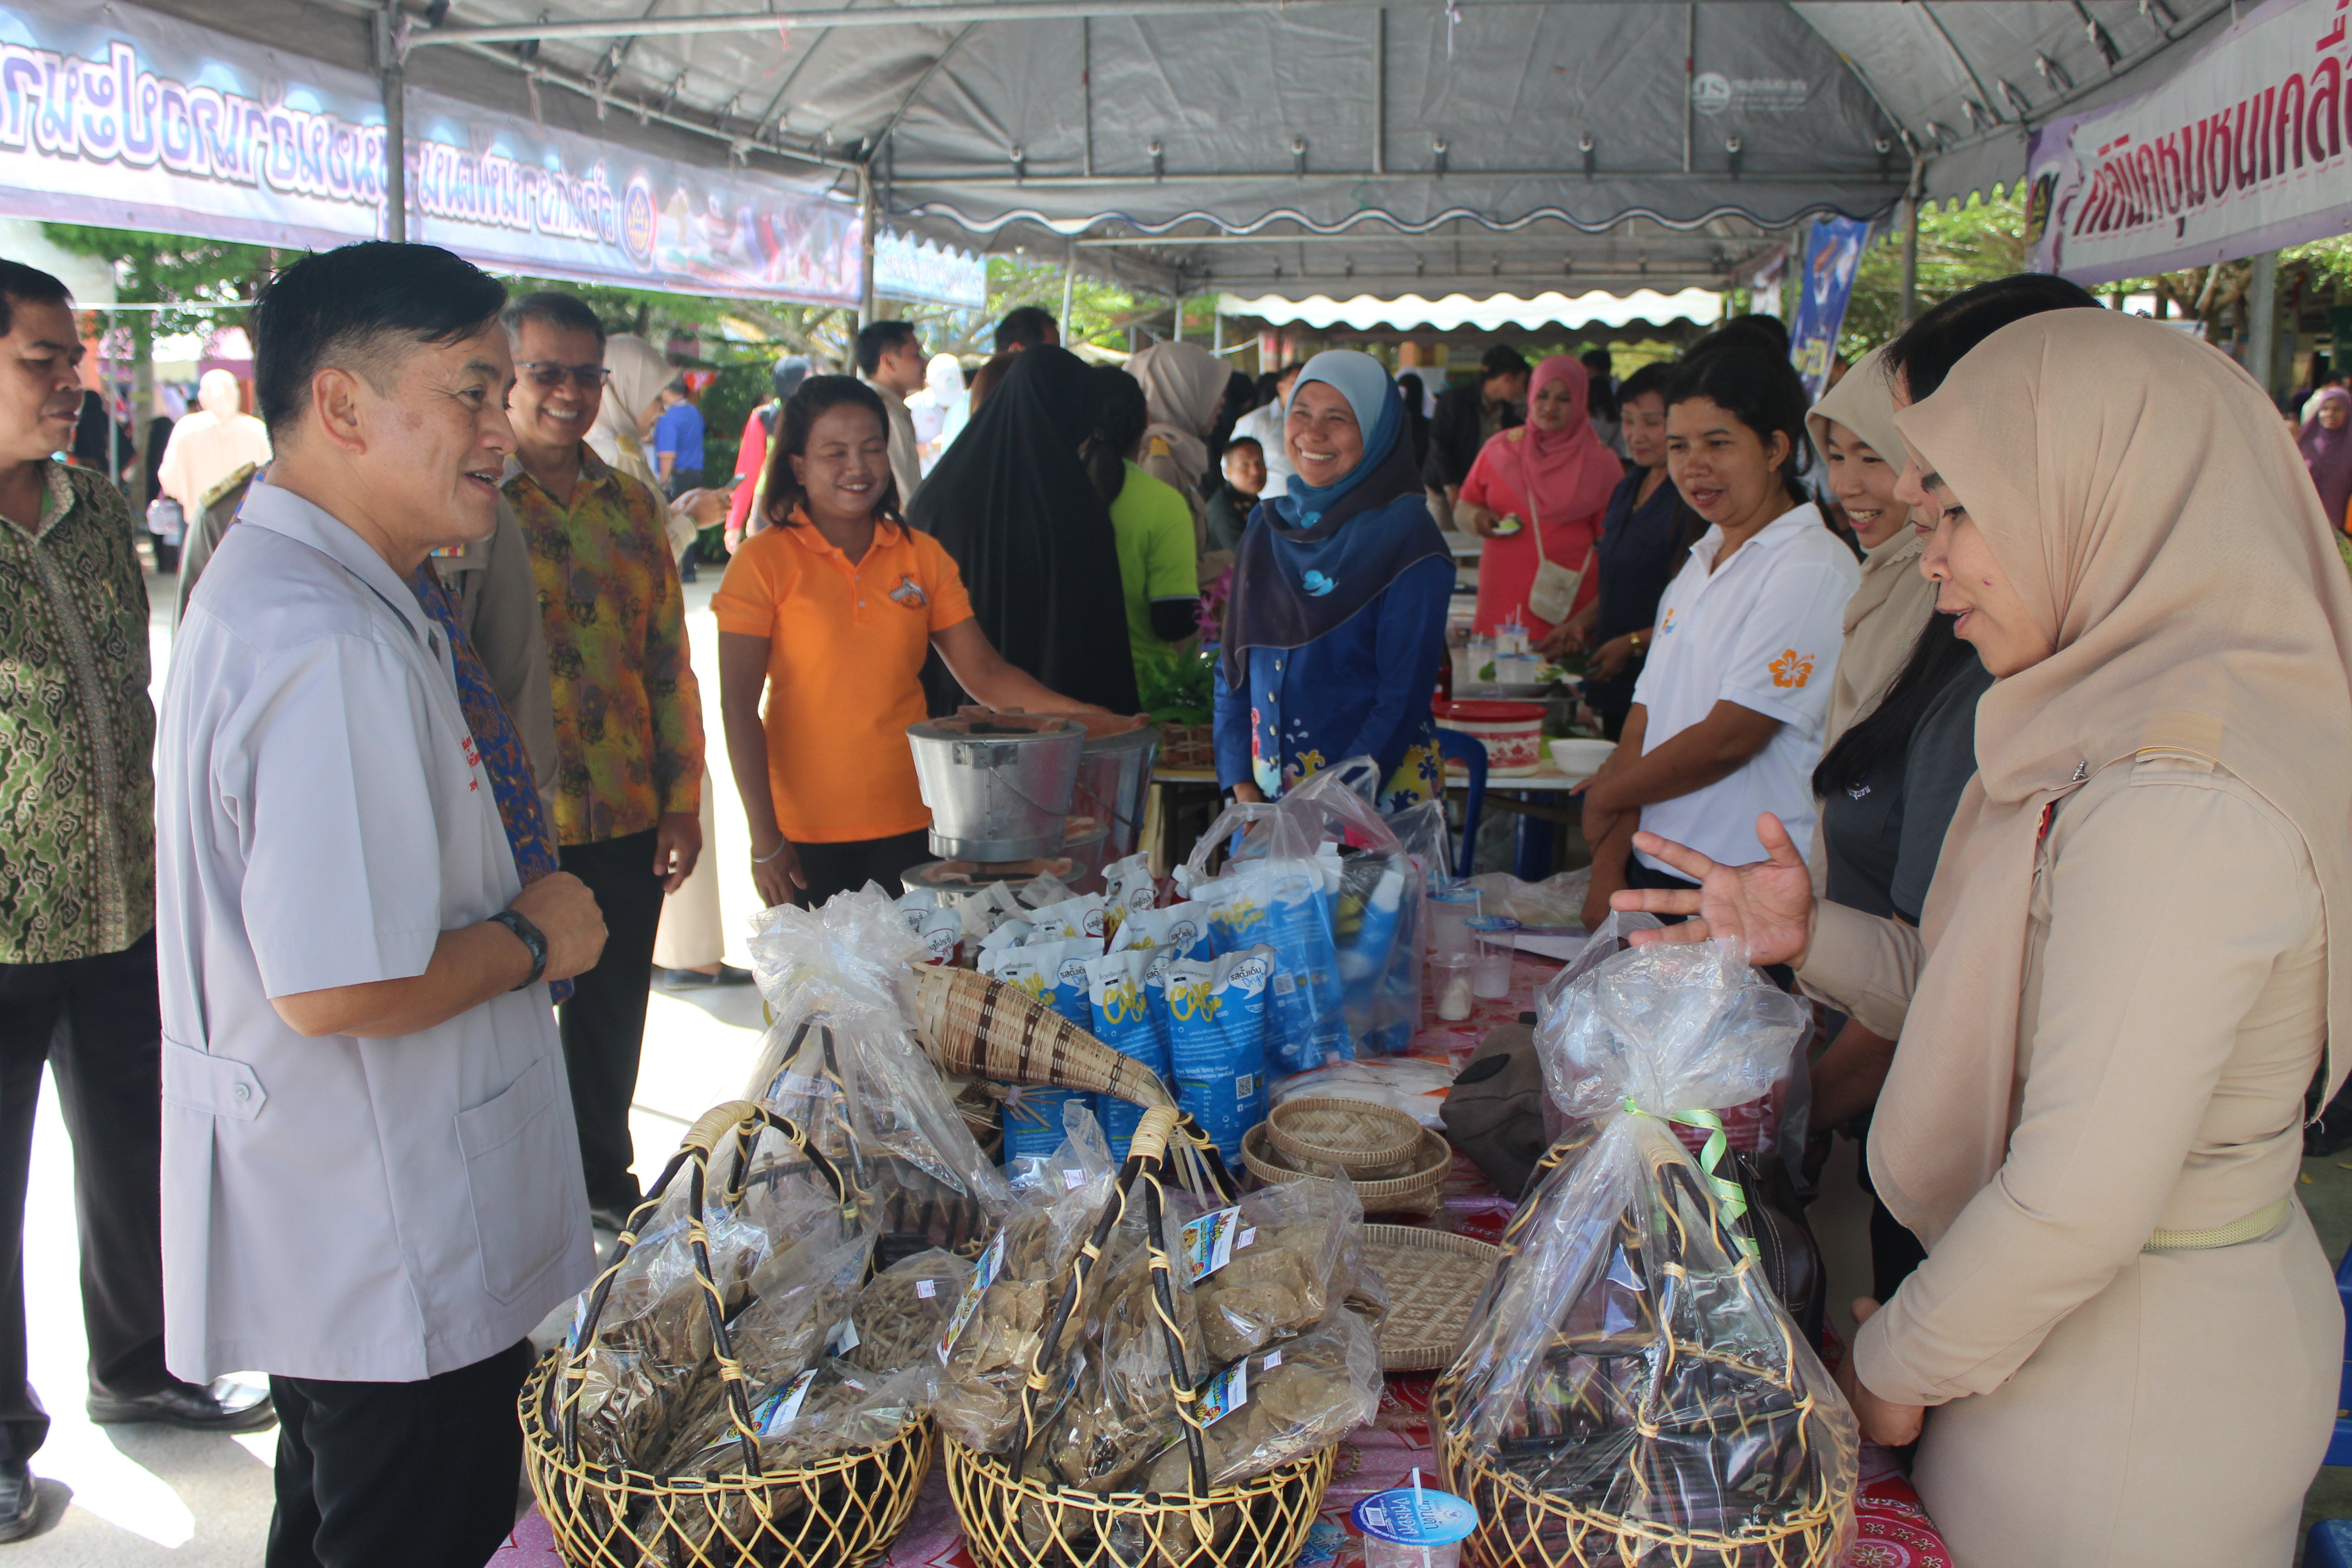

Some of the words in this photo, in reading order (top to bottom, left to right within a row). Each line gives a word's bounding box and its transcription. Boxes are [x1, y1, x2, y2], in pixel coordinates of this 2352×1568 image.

[2071, 0, 2352, 238] คลินิคชุมชนเคลื่
[1391, 1497, 1420, 1535] VANDA
